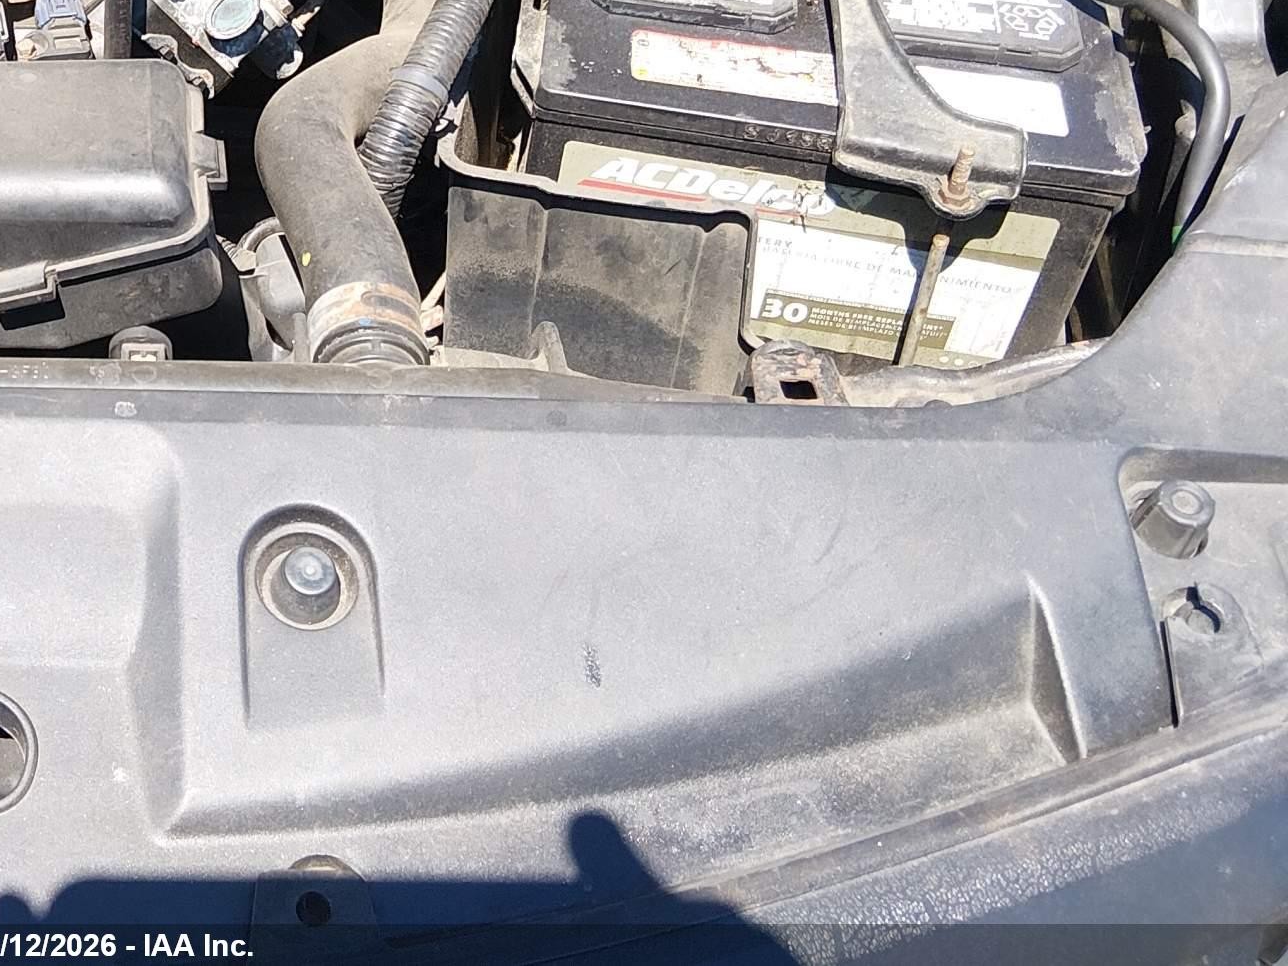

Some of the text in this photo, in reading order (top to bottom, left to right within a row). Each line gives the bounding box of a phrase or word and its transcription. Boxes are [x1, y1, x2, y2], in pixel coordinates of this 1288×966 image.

[591, 157, 837, 215] ACDelco
[762, 298, 808, 324] 30
[811, 307, 850, 318] MONTHS
